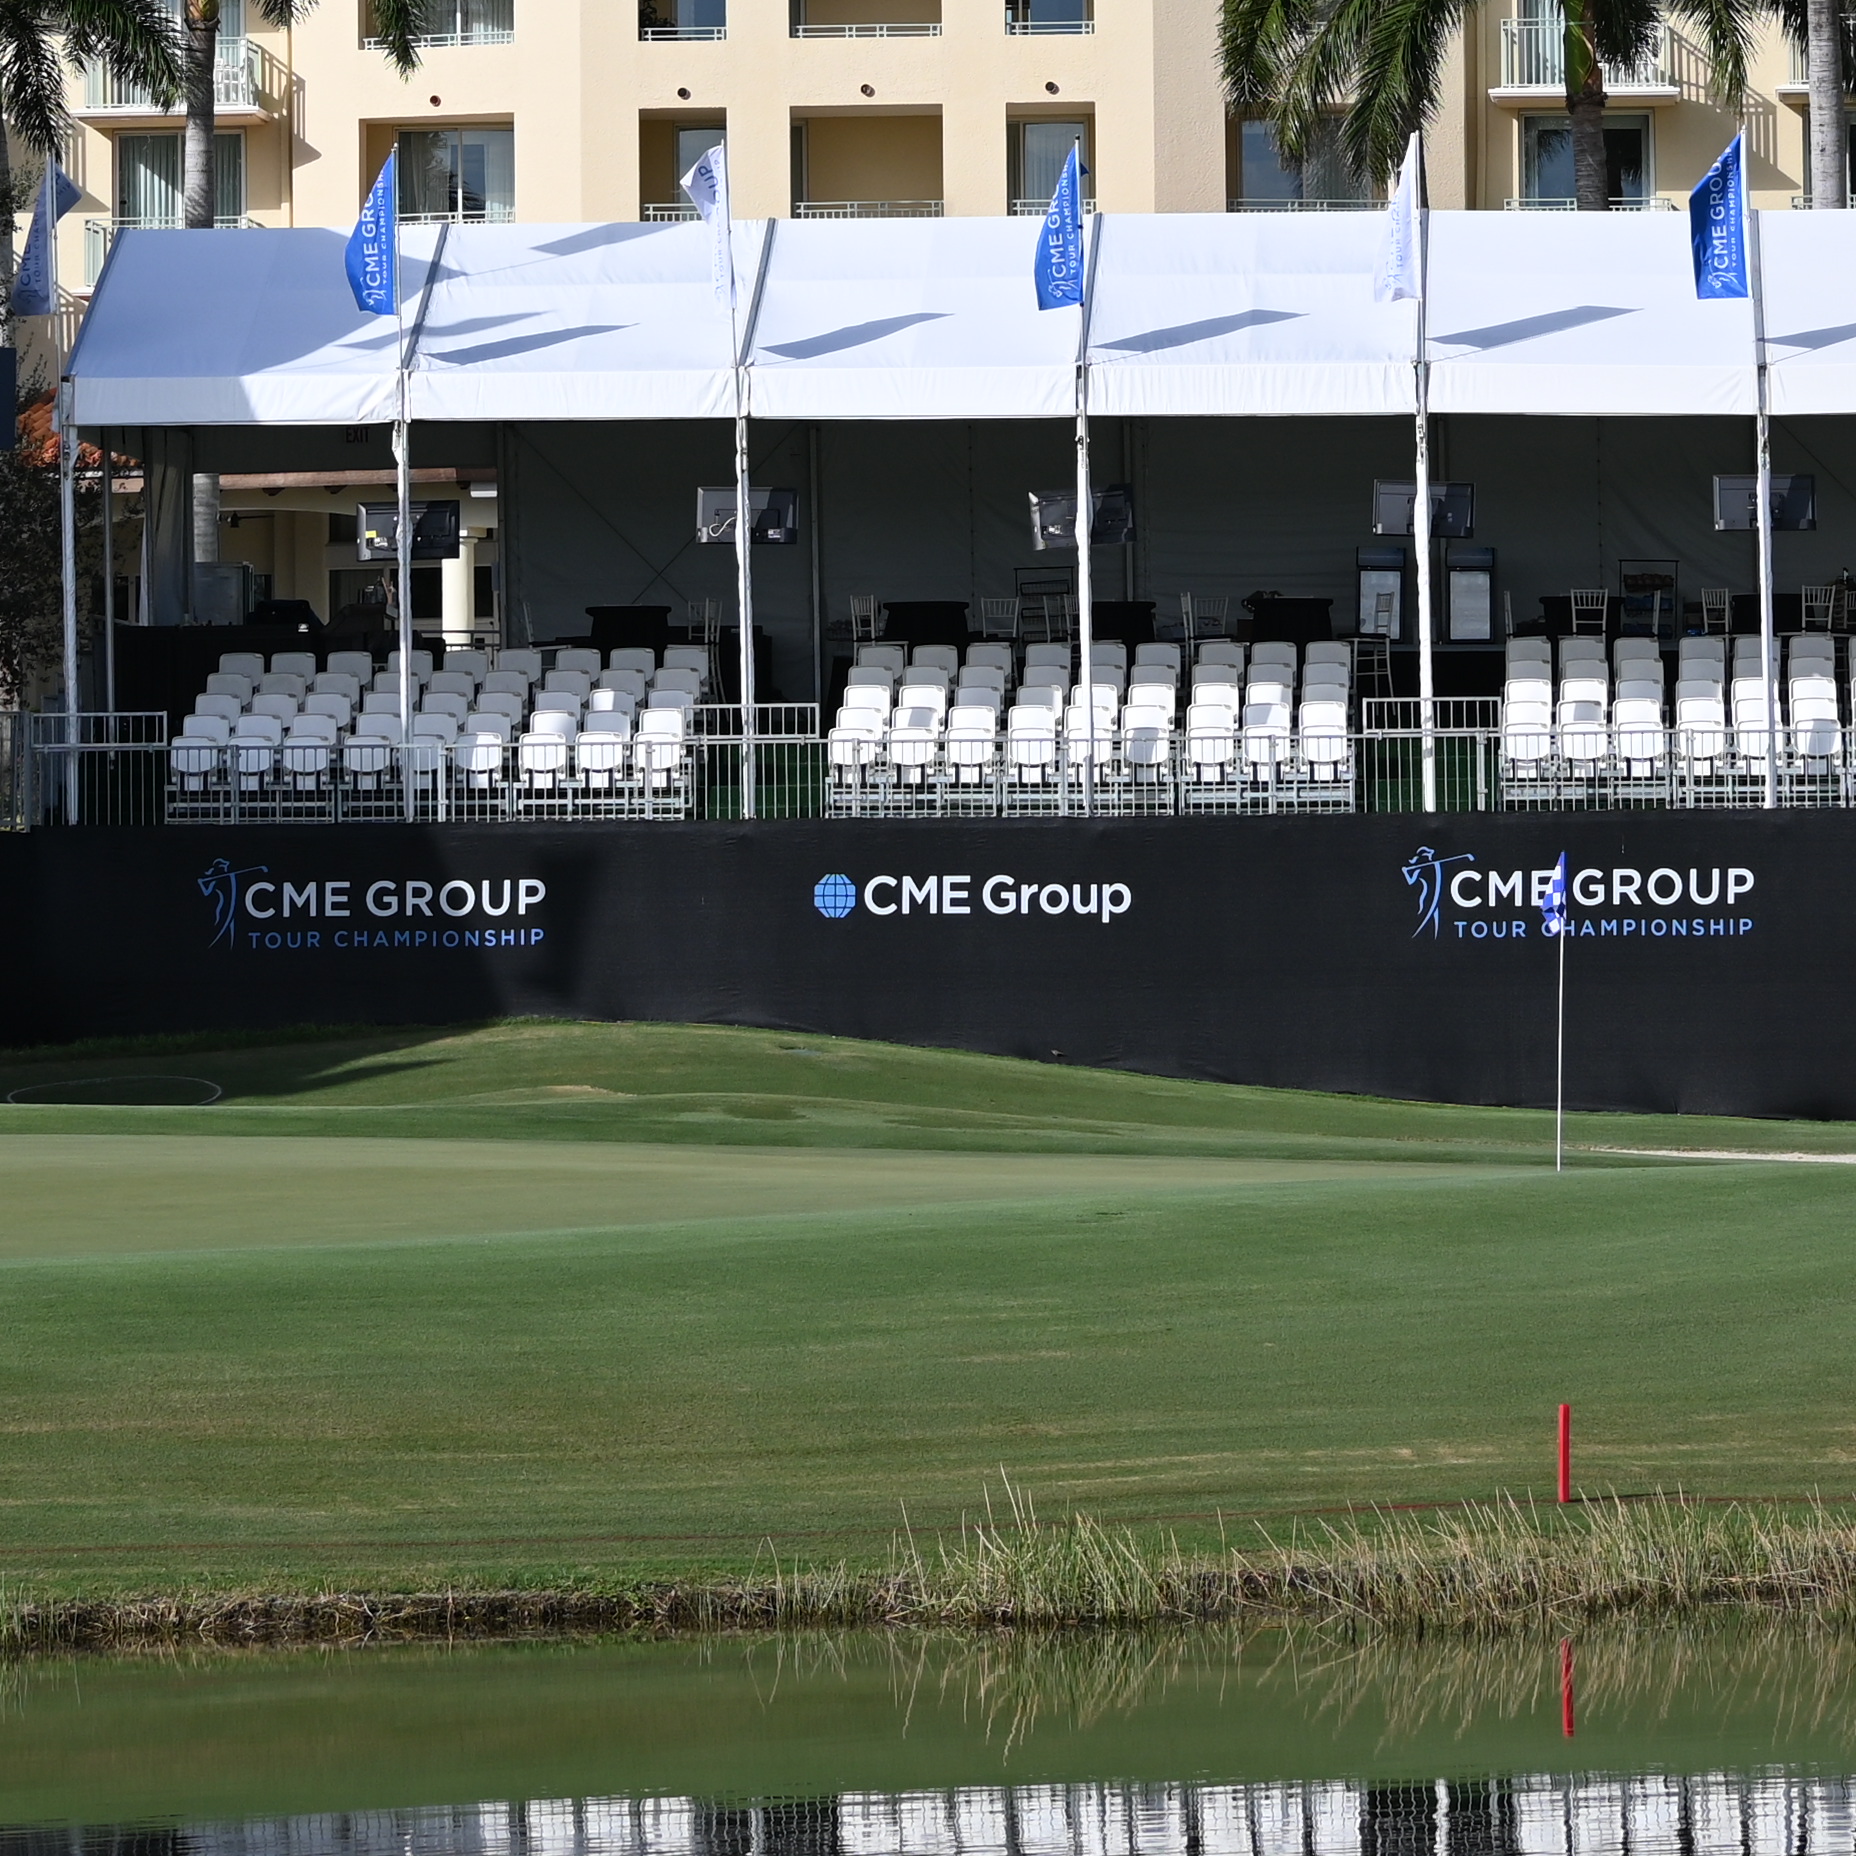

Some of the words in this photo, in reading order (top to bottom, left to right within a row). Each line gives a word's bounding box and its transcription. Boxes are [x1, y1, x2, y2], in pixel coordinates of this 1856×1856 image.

[1708, 160, 1726, 221] GROU
[363, 242, 381, 287] CME
[1049, 233, 1066, 277] CME
[1069, 245, 1077, 274] TOUR
[1712, 225, 1729, 269] CME
[346, 426, 370, 443] EXIT
[245, 882, 350, 918] CME
[366, 879, 545, 916] GROUP
[864, 875, 970, 915] CME
[983, 875, 1131, 923] Group
[1451, 870, 1555, 907] CME
[1573, 868, 1754, 906] GROUP
[248, 931, 320, 948] TOUR
[335, 929, 543, 946] CHAMPIONSHIP
[1454, 921, 1525, 938] TOUR
[1541, 918, 1752, 937] CHAMPIONSHIP
